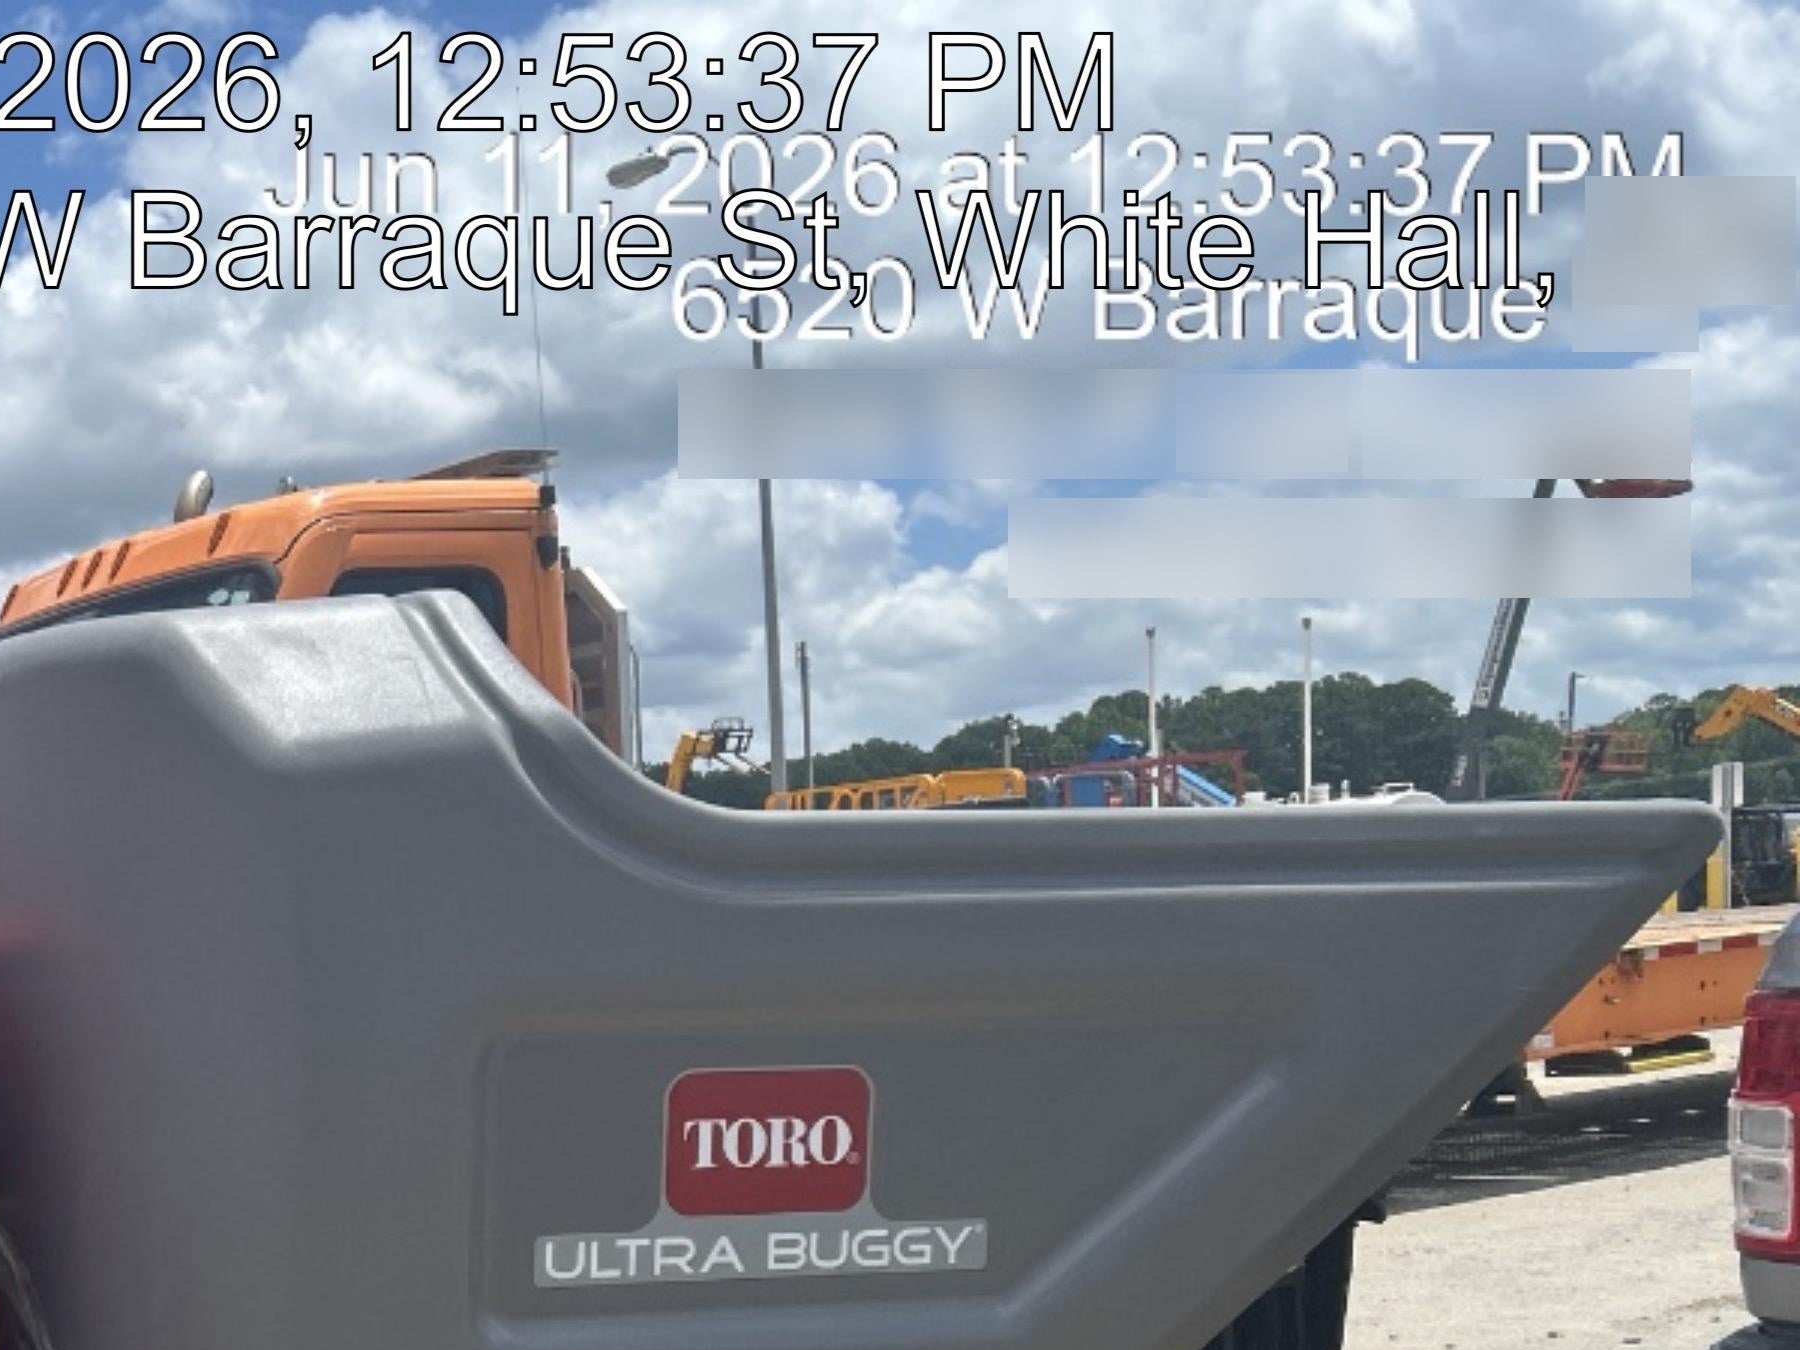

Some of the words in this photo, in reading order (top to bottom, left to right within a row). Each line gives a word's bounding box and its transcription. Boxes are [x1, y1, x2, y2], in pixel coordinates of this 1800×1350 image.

[682, 1114, 855, 1170] TORO
[544, 1235, 745, 1280] ULTRA
[766, 1226, 977, 1271] BUGGY
